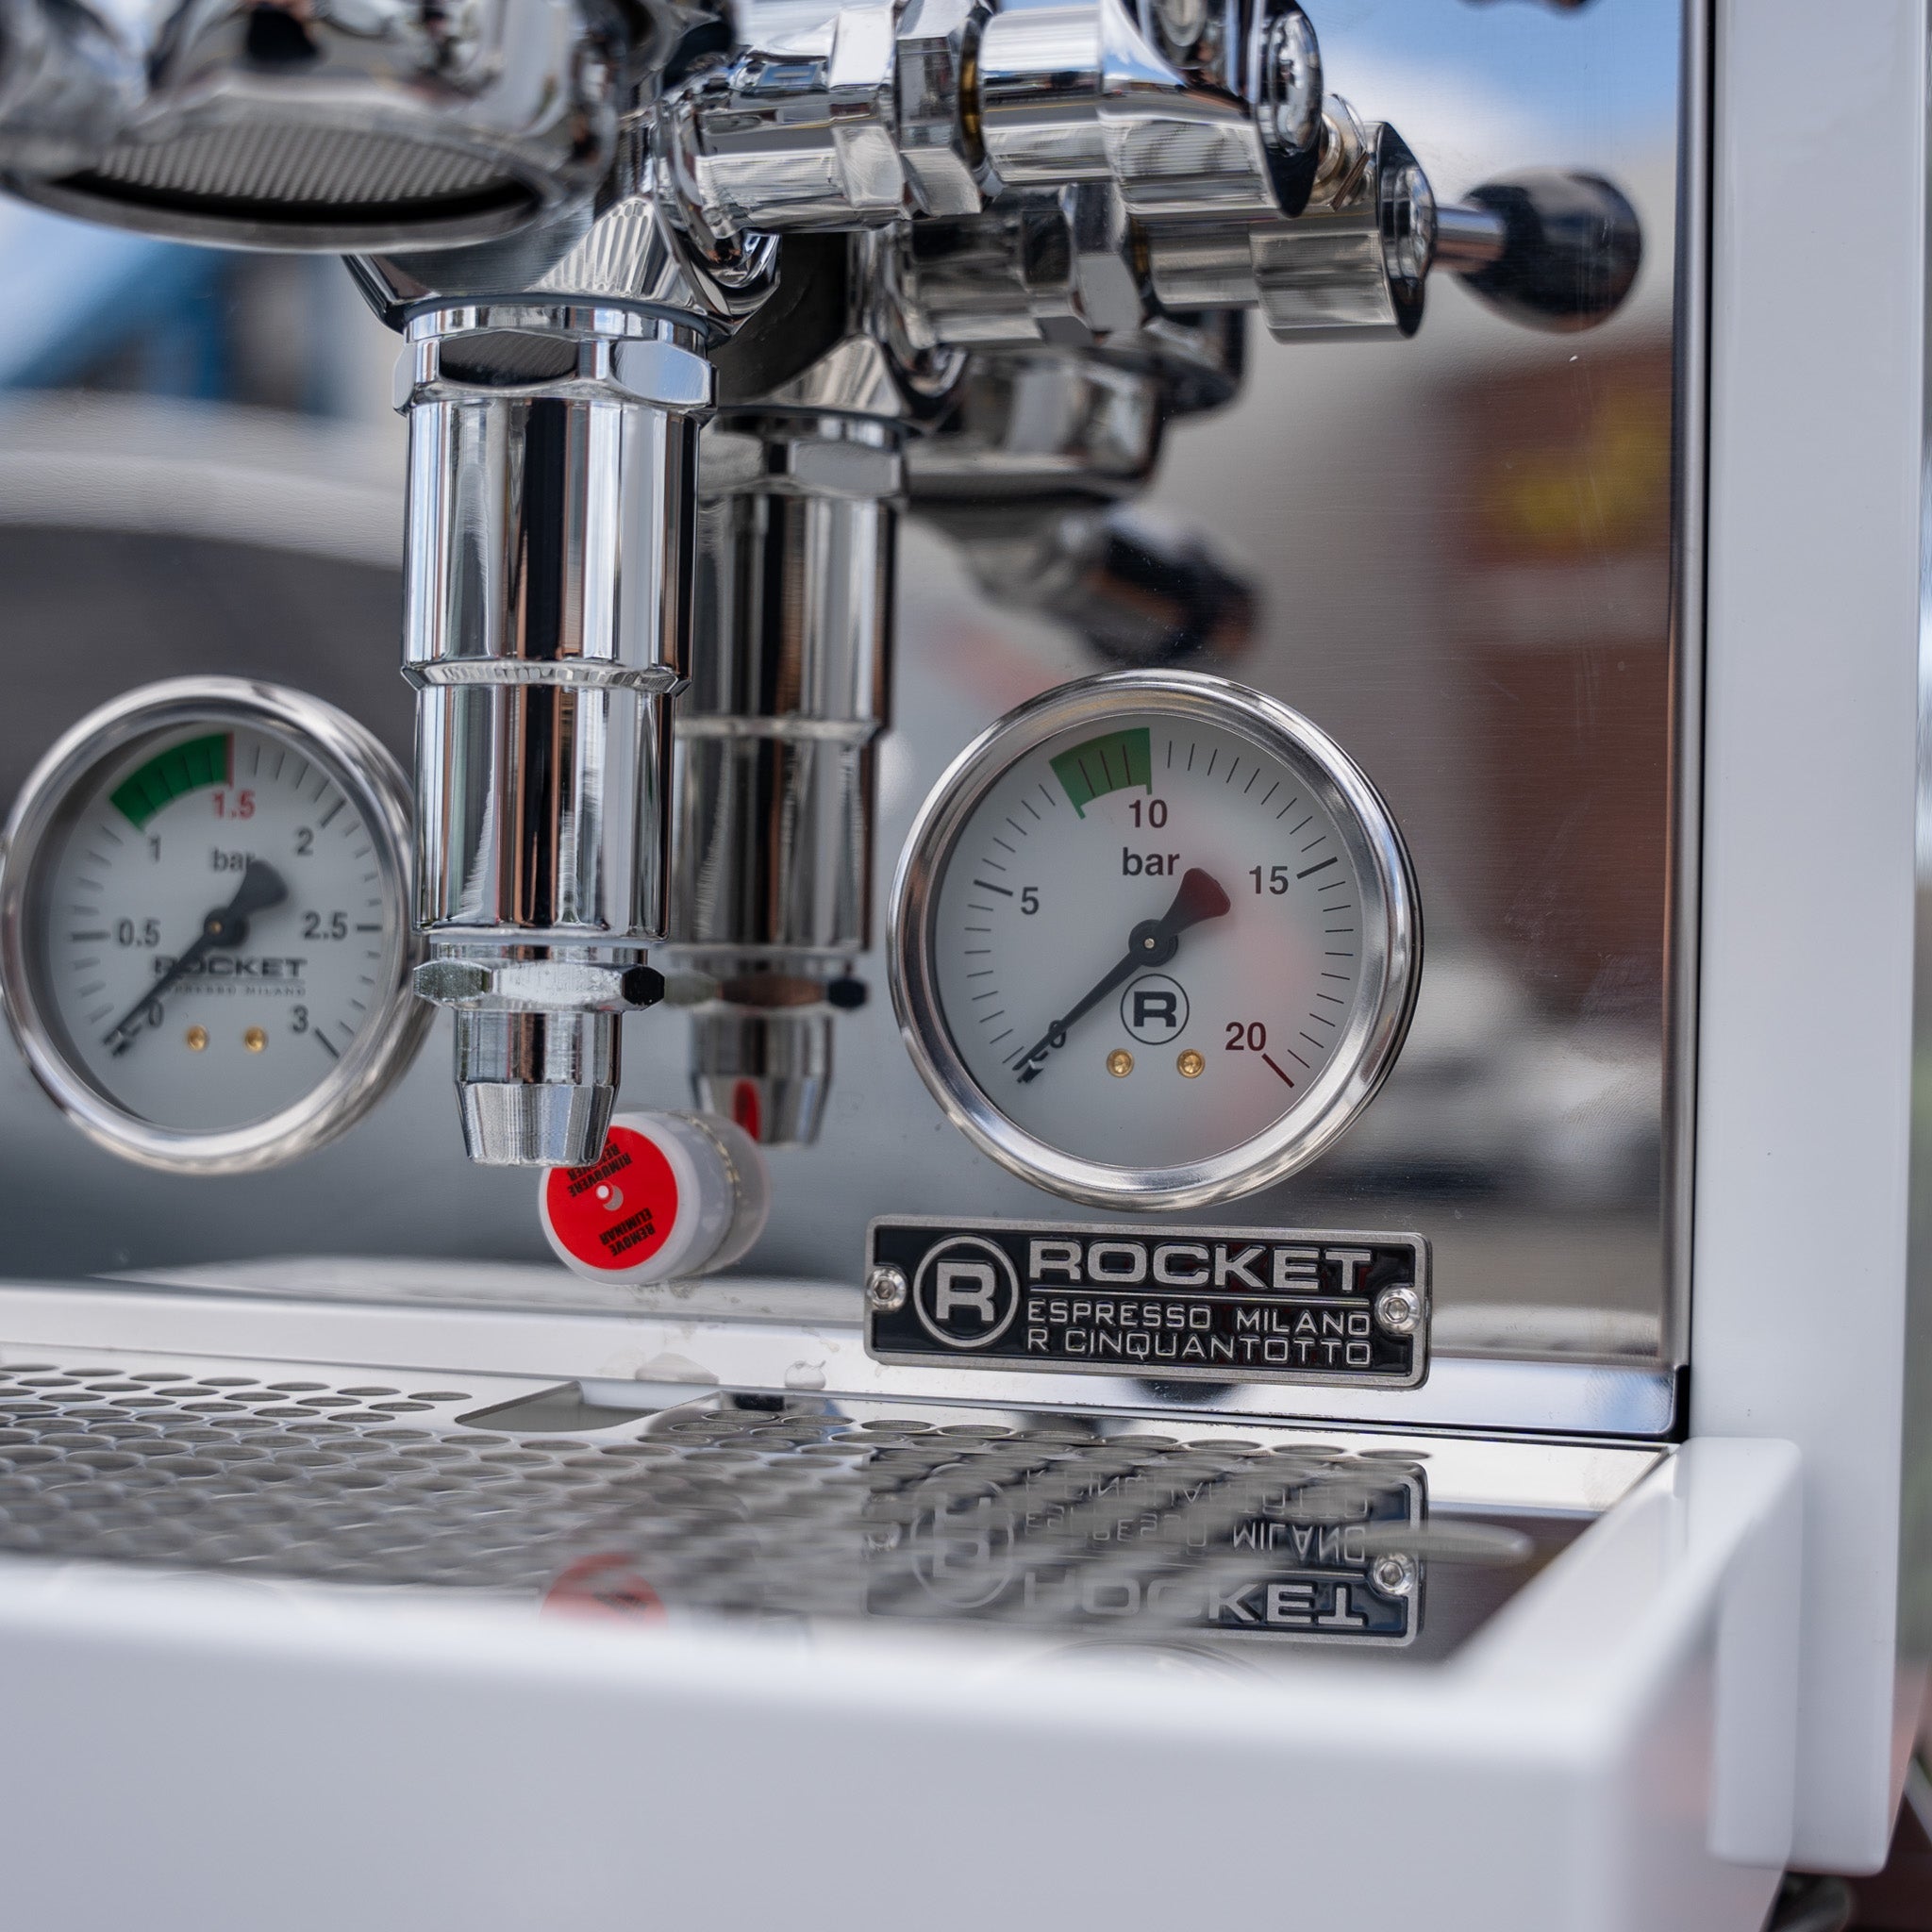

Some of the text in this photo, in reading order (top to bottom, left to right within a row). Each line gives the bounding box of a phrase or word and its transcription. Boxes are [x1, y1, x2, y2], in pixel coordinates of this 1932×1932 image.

[212, 791, 256, 820] 1.5
[1128, 799, 1168, 828] 10
[149, 835, 161, 862] 1
[297, 827, 314, 856] 2
[212, 849, 256, 872] bar
[1122, 847, 1180, 875] bar
[1249, 865, 1289, 895] 15
[1021, 887, 1040, 916] 5
[119, 918, 160, 947] 0.5
[303, 911, 348, 940] 2.5
[148, 1001, 164, 1028] 0
[291, 1005, 308, 1034] 3
[1133, 991, 1177, 1027] R
[1225, 1022, 1267, 1052] 20
[567, 1152, 632, 1197] RIMUOVERE
[599, 1208, 653, 1246] ELIMINAR
[608, 1222, 656, 1257] REMOVE
[1028, 1240, 1372, 1291] ROCKET
[936, 1262, 996, 1322] R
[1027, 1299, 1371, 1336] ESPRESSO MILANO
[1027, 1327, 1371, 1365] R CINQUANTOTTO
